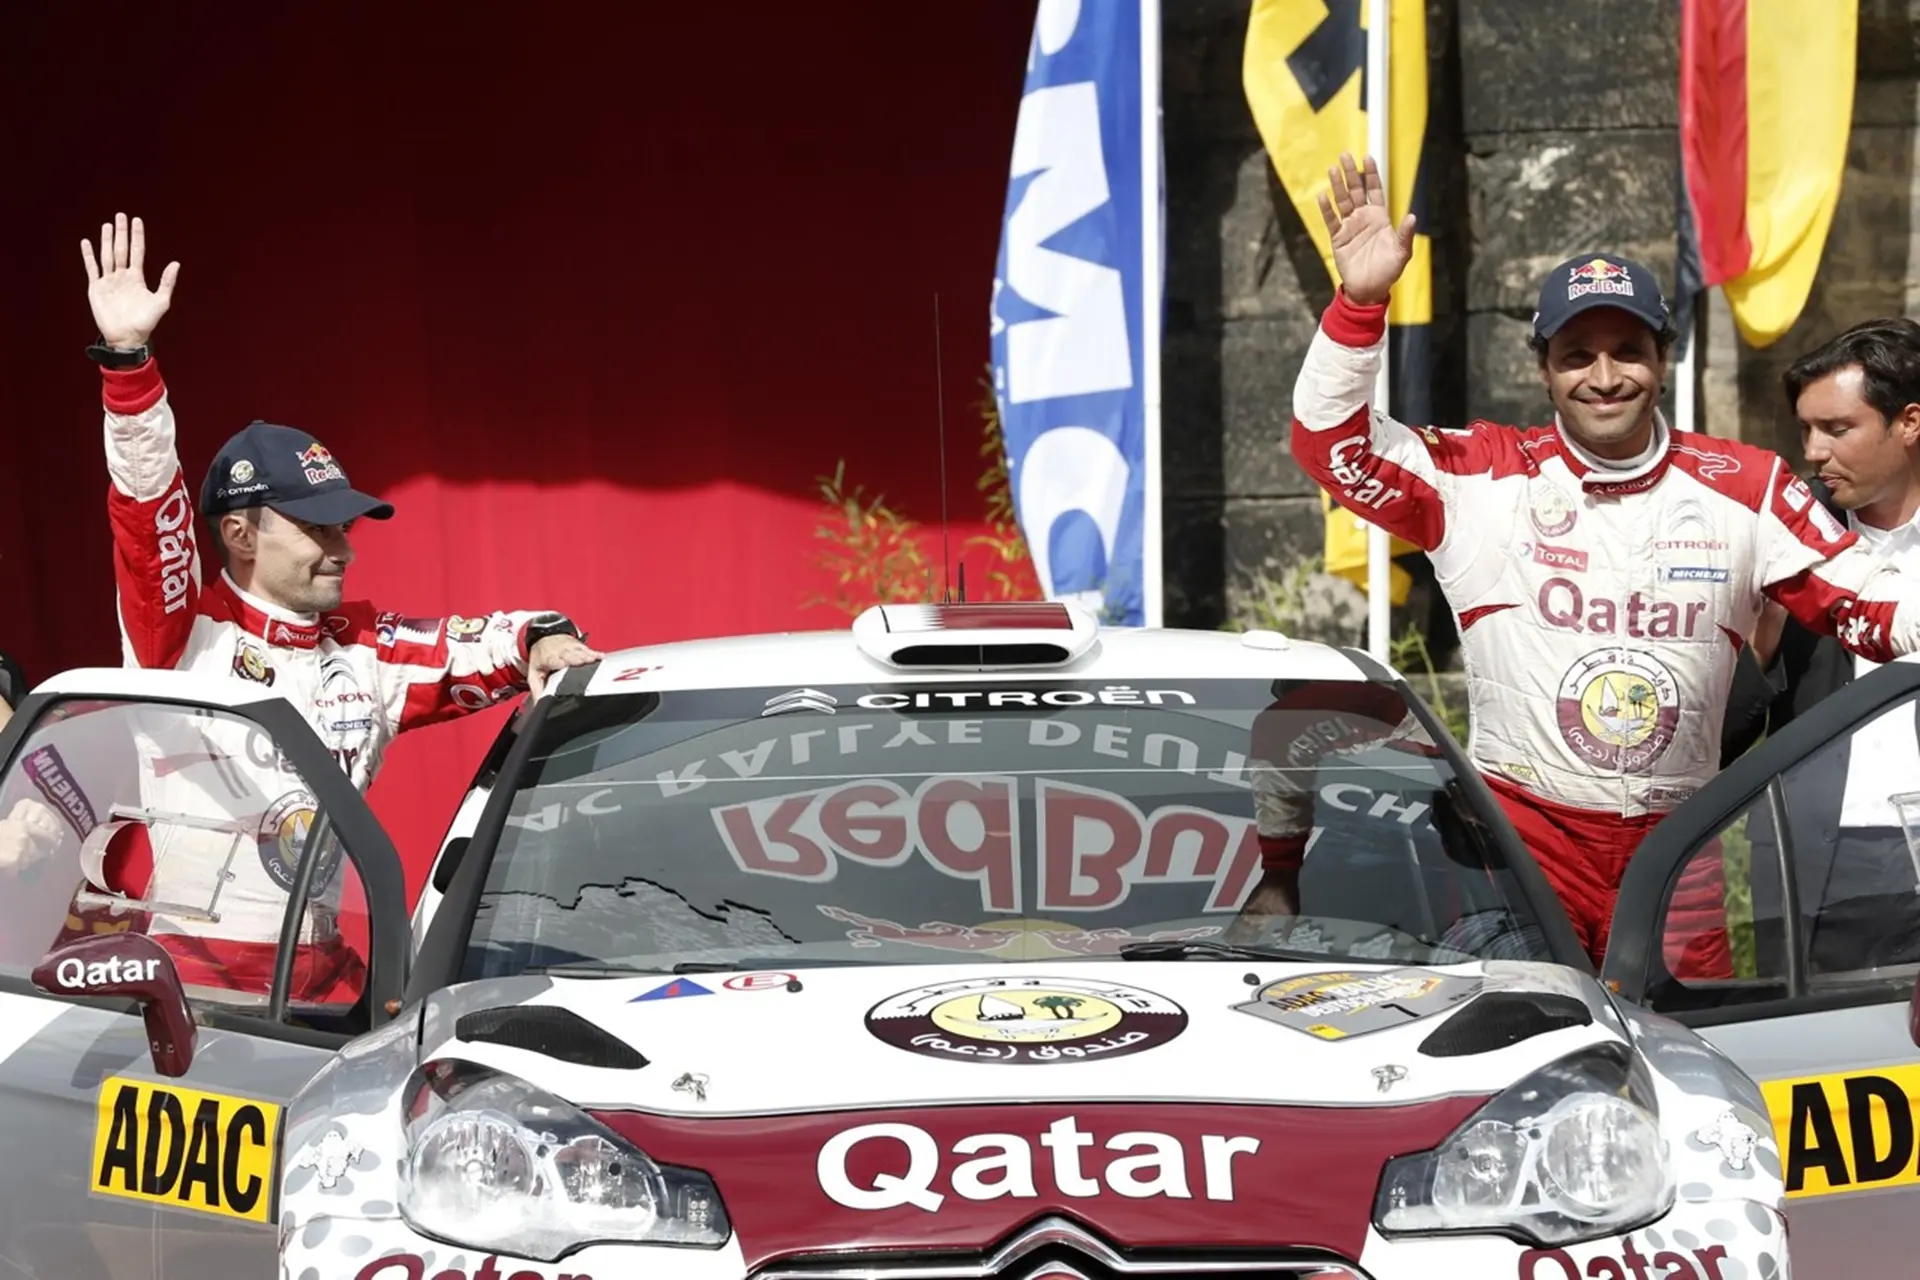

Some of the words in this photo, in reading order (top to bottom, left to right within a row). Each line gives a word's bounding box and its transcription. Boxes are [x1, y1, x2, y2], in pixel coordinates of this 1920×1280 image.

[1568, 279, 1600, 300] Red
[1601, 279, 1634, 297] Bull
[155, 489, 191, 615] Qatar
[1671, 569, 1727, 581] MICHELIN
[1538, 577, 1707, 639] Qatar
[56, 954, 161, 989] Qatar
[99, 1085, 266, 1215] ADAC
[816, 1115, 1261, 1213] Qatar
[1785, 1075, 1920, 1192] AD
